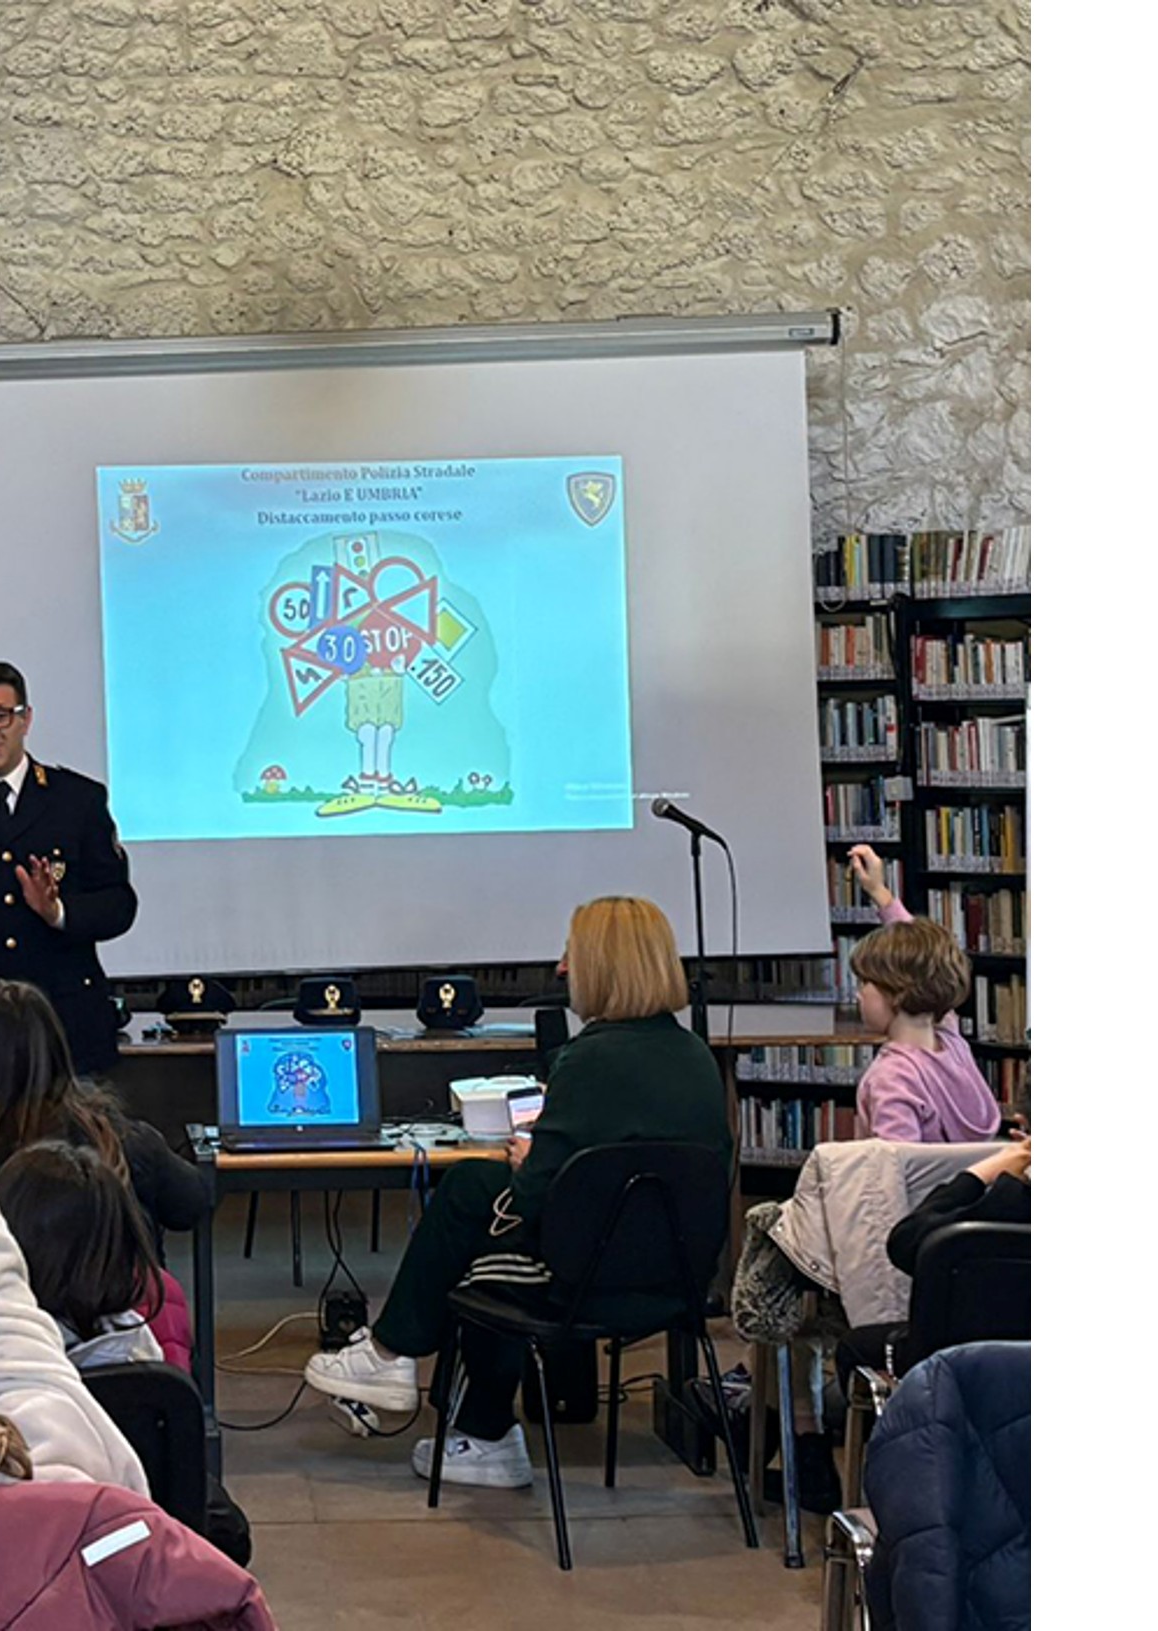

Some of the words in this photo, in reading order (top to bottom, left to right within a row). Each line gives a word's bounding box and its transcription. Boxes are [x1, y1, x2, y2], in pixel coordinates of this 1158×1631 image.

[241, 468, 359, 483] Compartimento
[360, 466, 411, 481] Polizia
[413, 464, 476, 479] Stradale
[344, 488, 354, 501] E
[257, 510, 367, 525] Distaccamento
[369, 511, 412, 525] passo
[413, 509, 463, 522] corese
[283, 598, 310, 621] 50
[324, 634, 356, 662] 30
[360, 626, 413, 654] STOP
